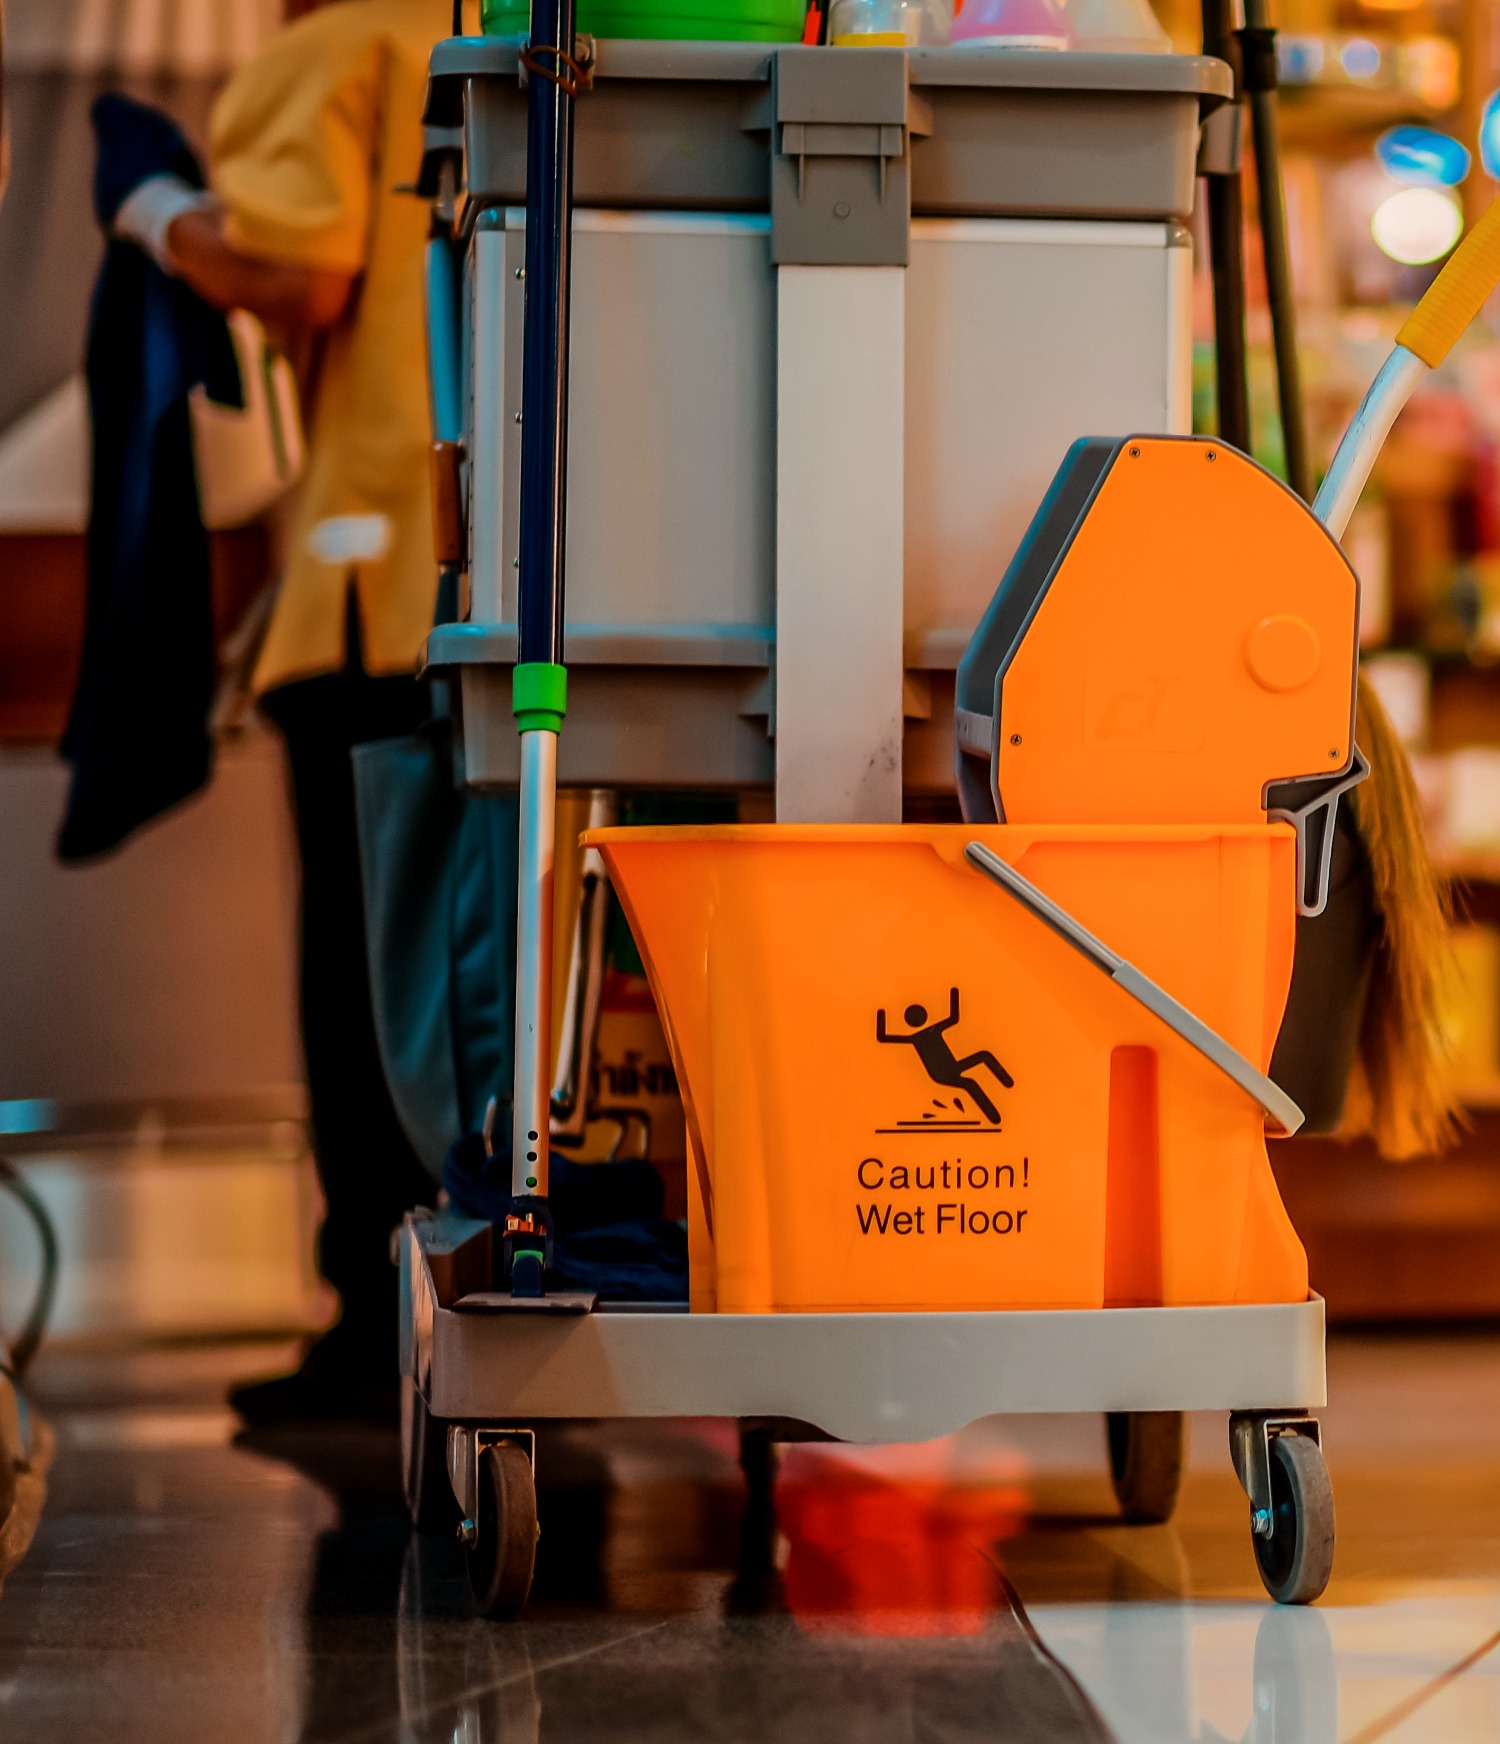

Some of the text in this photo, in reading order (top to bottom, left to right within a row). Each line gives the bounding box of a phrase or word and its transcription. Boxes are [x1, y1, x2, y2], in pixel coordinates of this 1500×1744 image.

[857, 1157, 1029, 1190] Caution!
[856, 1203, 1028, 1235] Wet Floor
